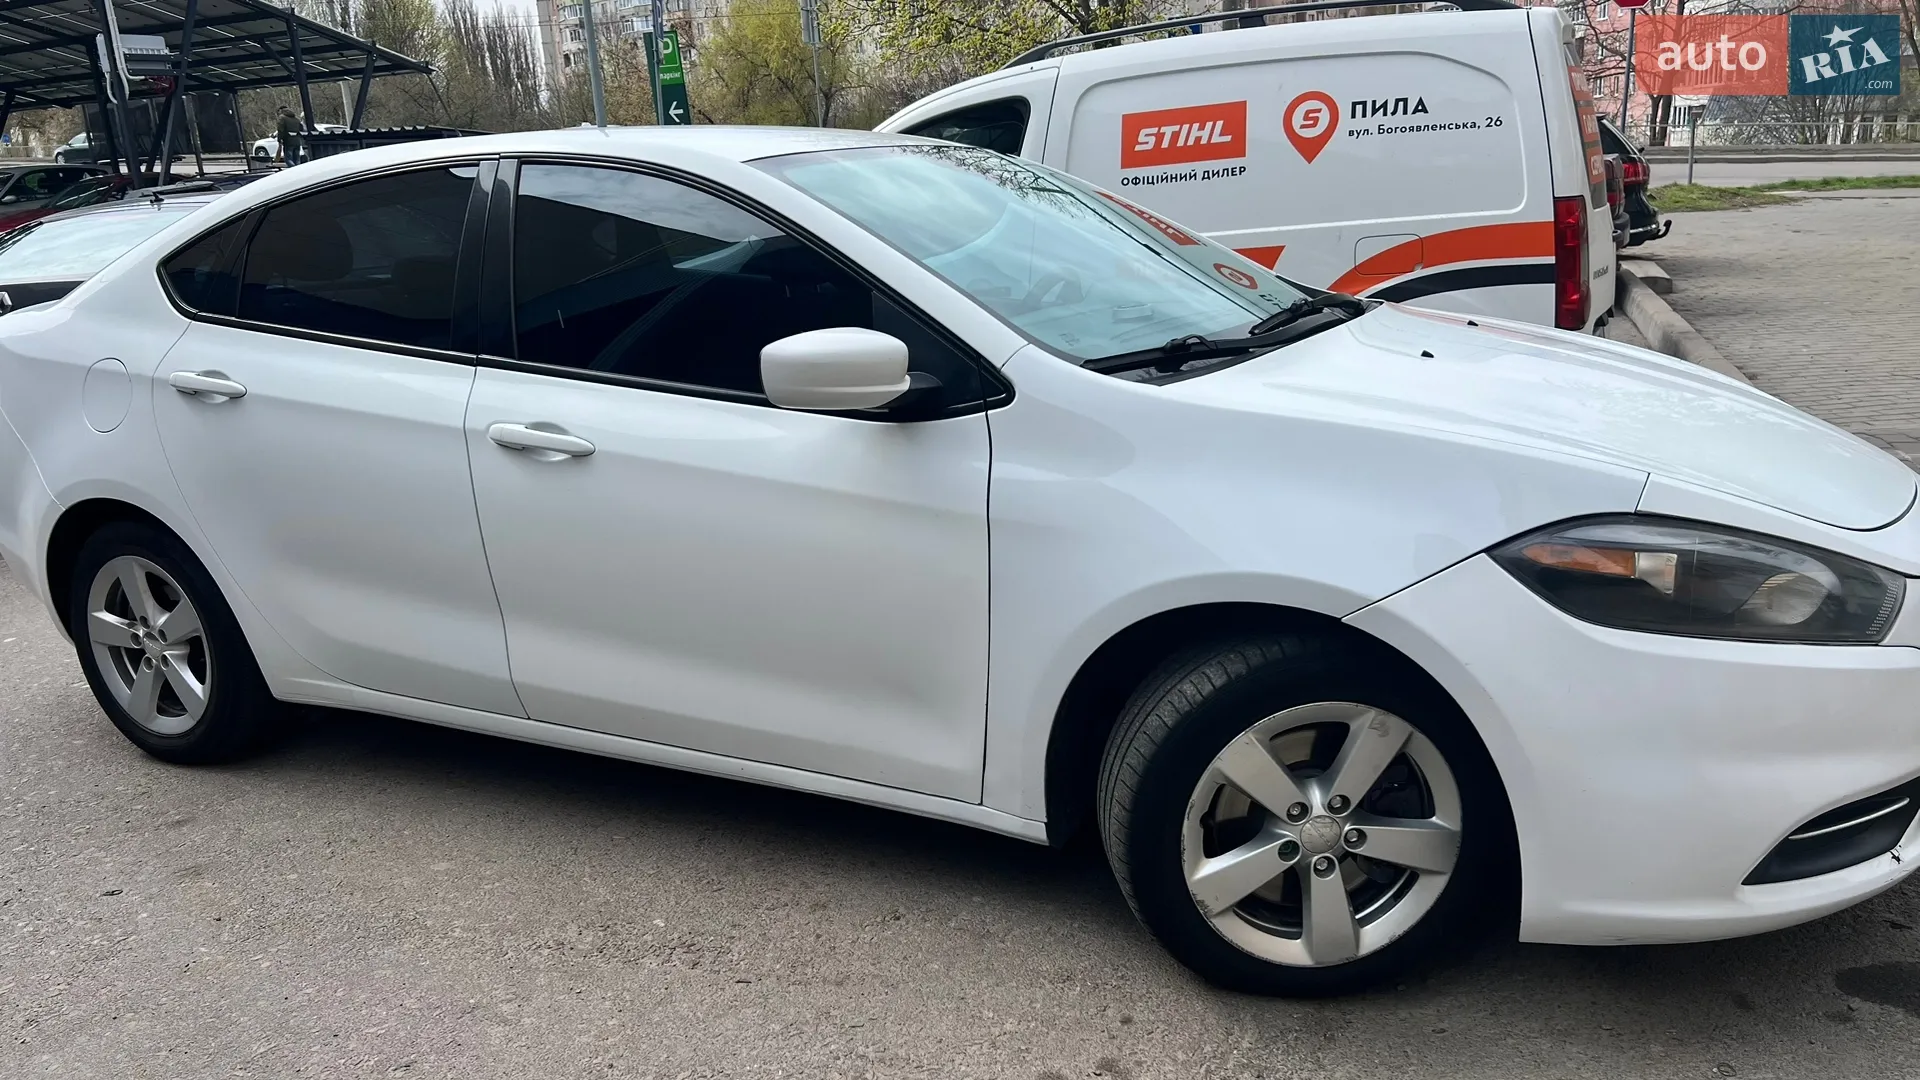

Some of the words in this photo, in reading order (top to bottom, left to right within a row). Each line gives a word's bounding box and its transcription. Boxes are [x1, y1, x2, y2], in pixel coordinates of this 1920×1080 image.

[1299, 108, 1323, 130] S
[1351, 96, 1429, 119] ПИЛА
[1134, 121, 1233, 151] STIHL
[1348, 128, 1373, 140] вул.
[1377, 121, 1481, 135] Богоявленська,
[1485, 116, 1503, 128] 26
[1121, 169, 1197, 187] ОФІЦІЙНИЙ
[1201, 166, 1247, 181] ДИЛЕР
